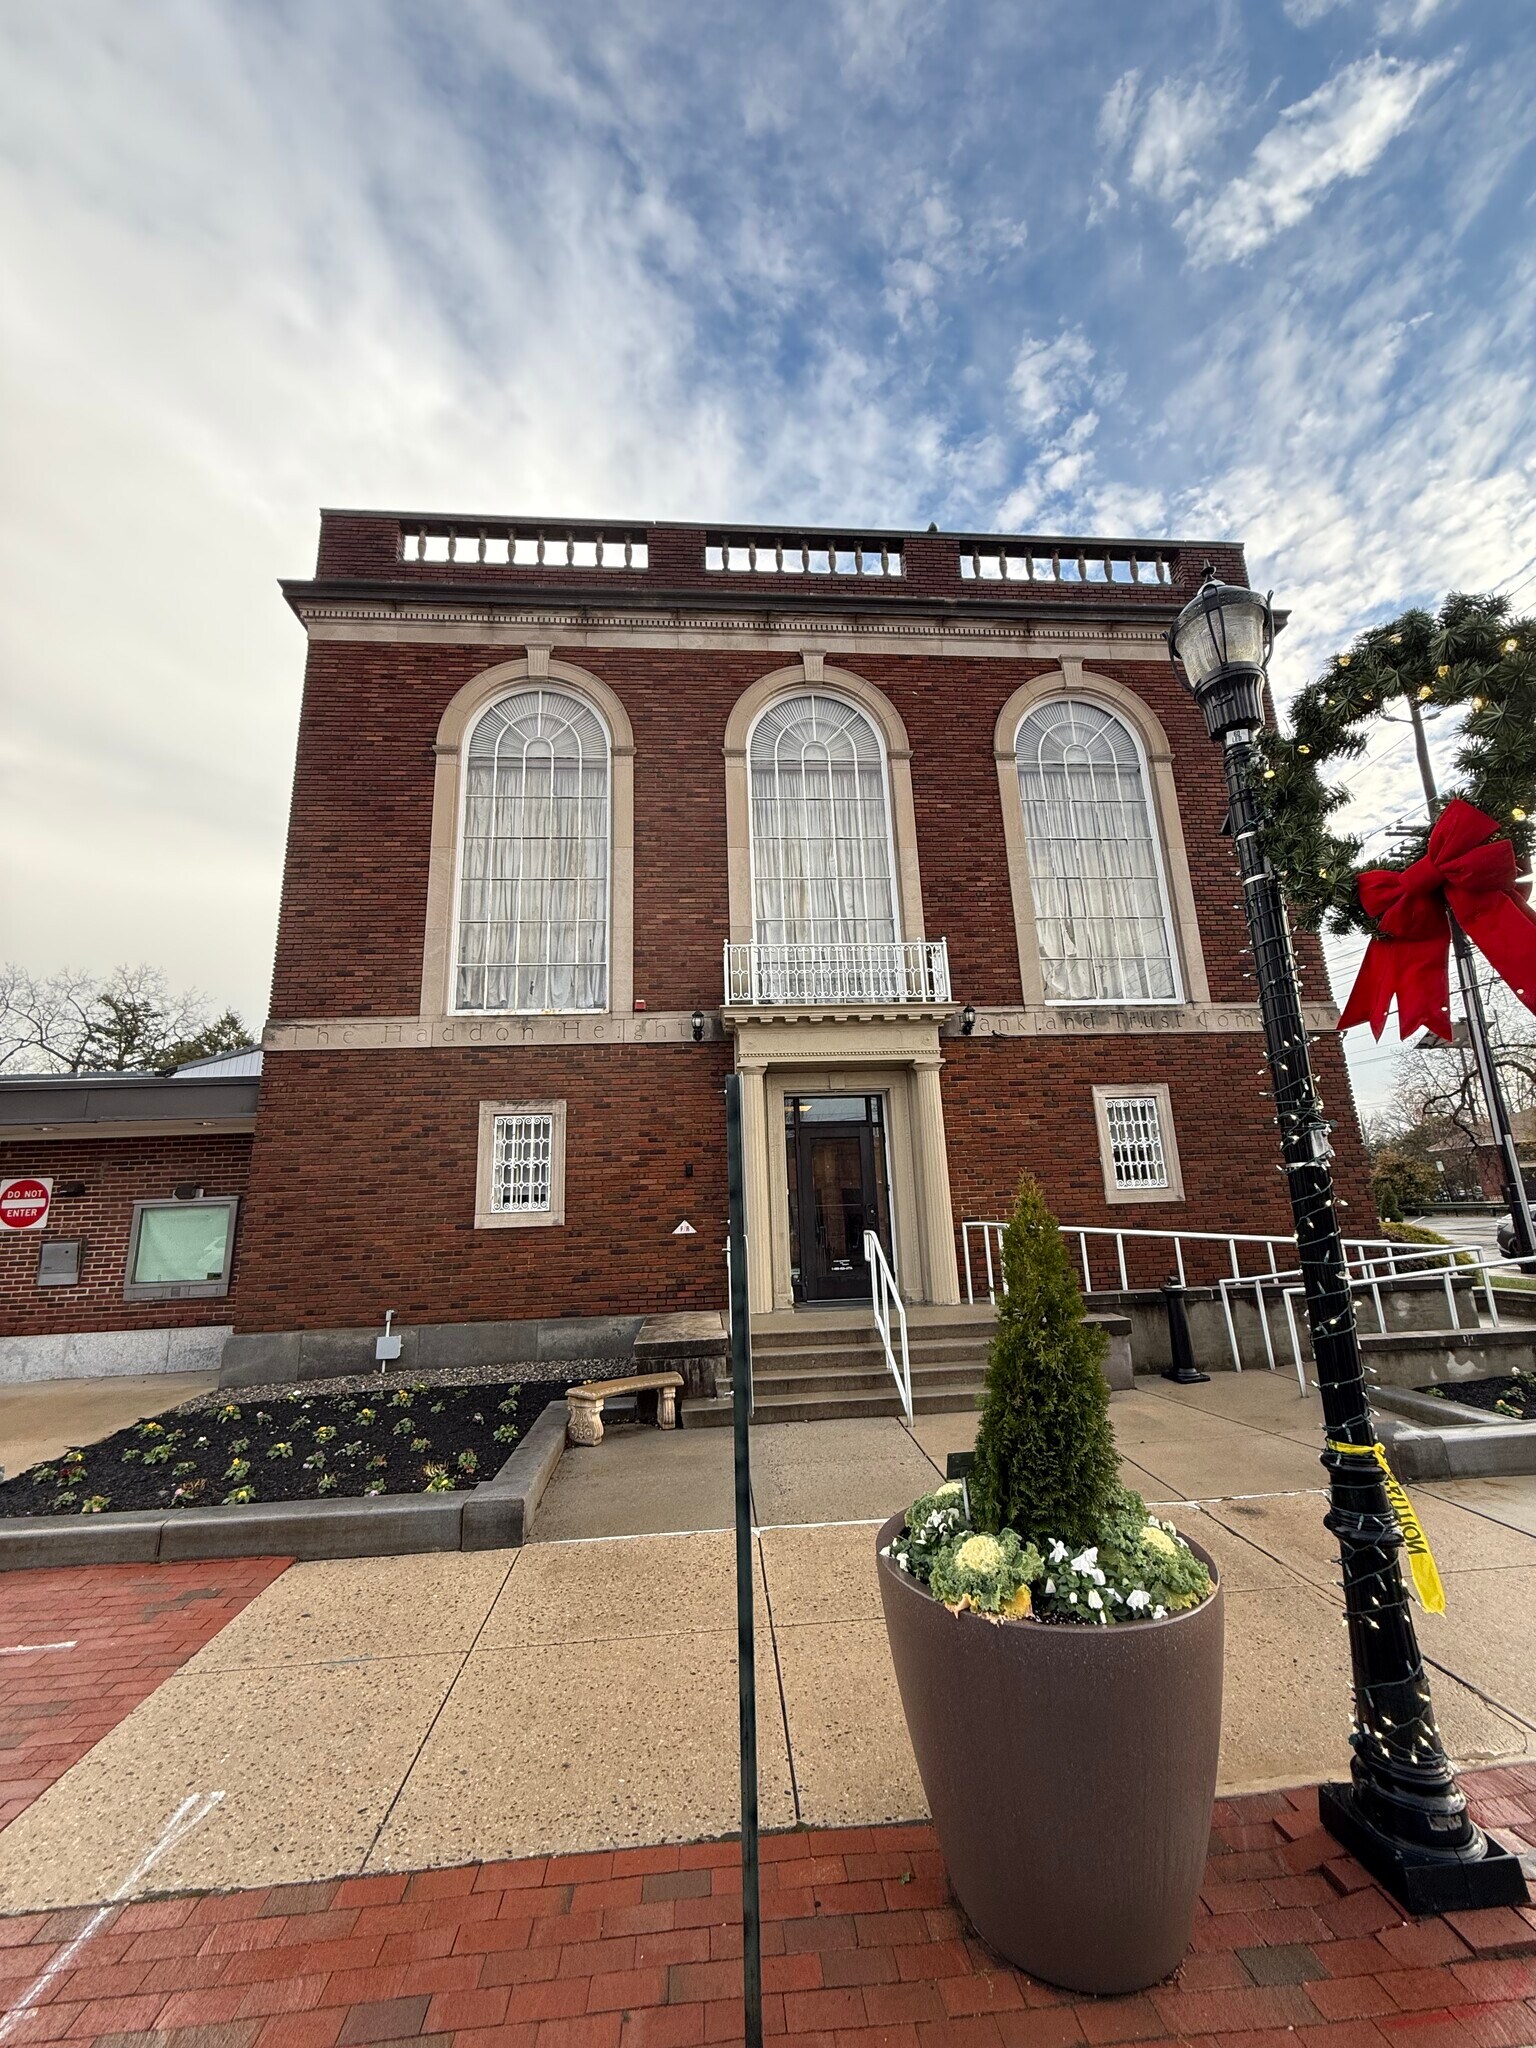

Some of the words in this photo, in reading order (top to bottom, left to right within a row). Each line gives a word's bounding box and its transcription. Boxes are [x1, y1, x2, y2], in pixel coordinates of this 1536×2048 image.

[289, 1026, 354, 1045] The
[384, 1023, 534, 1043] Haddon
[562, 1020, 705, 1041] Height
[1045, 1012, 1096, 1031] and
[1111, 1011, 1184, 1030] Trust
[1198, 1008, 1321, 1029] Comy
[7, 1190, 21, 1199] DO
[24, 1189, 43, 1198] NOT
[6, 1208, 38, 1218] ENTER
